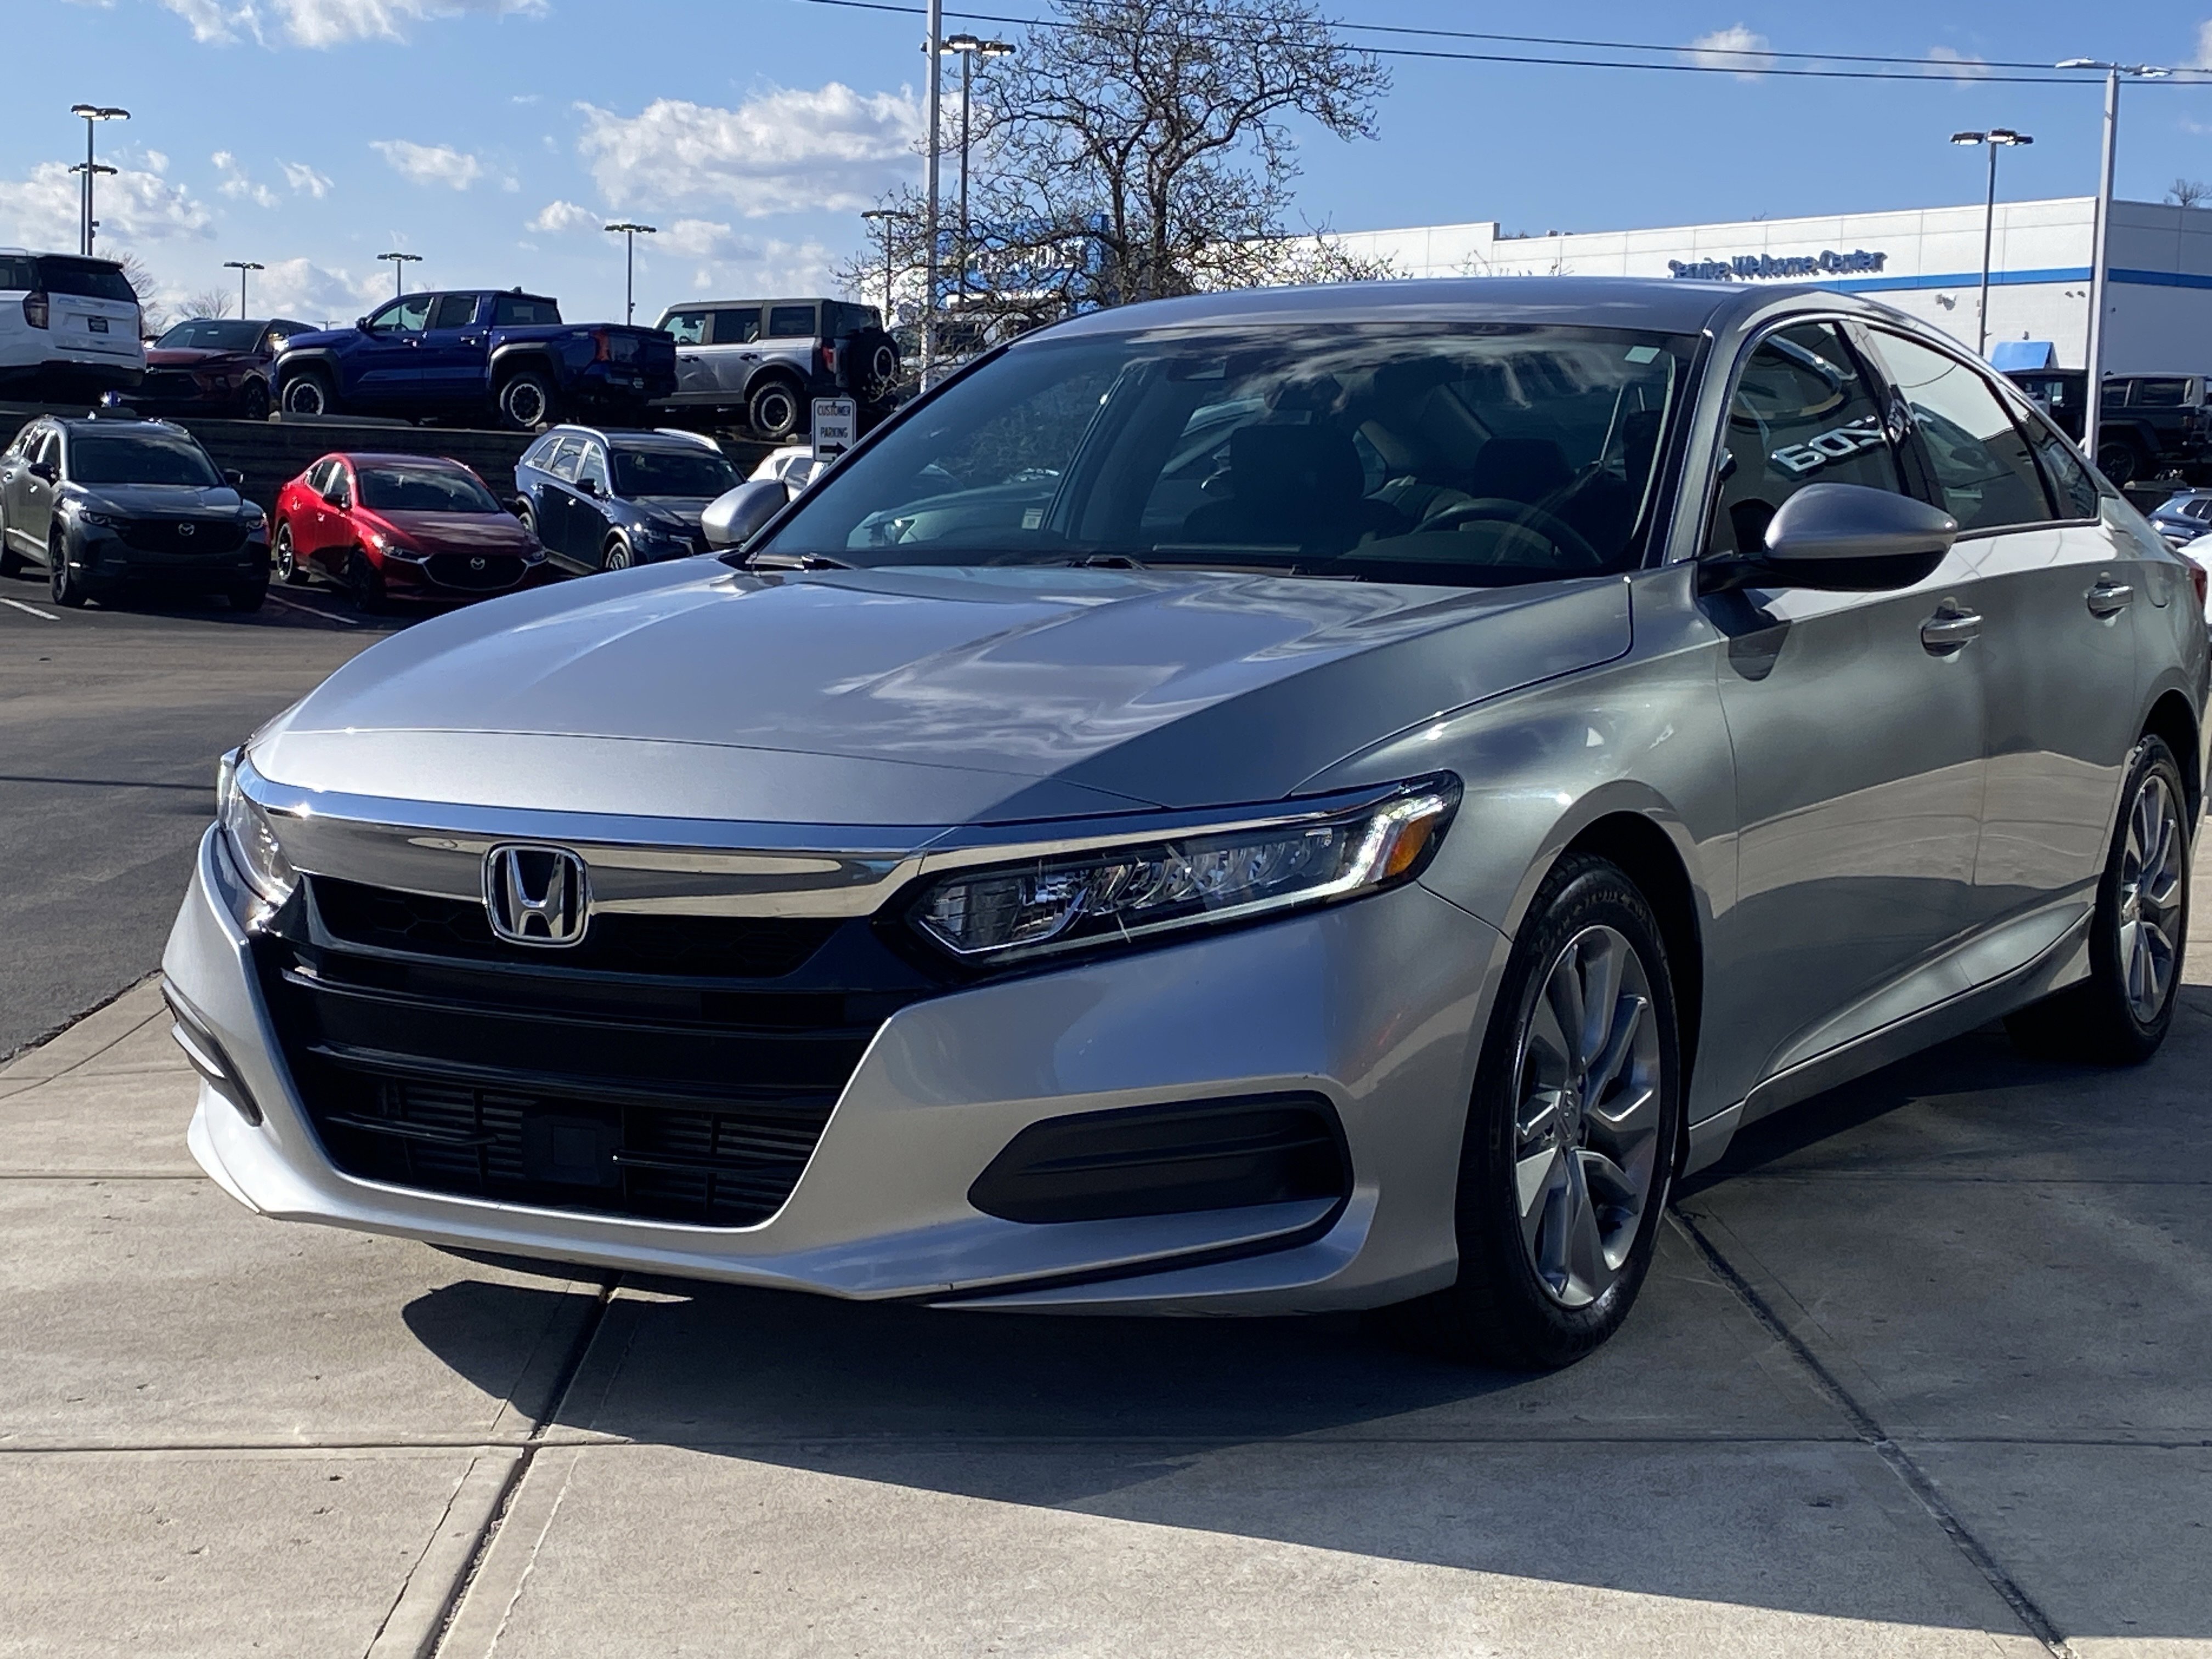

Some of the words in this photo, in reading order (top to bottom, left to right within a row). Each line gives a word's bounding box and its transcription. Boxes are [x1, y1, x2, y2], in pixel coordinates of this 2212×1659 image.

[1820, 249, 1888, 274] Center
[817, 406, 850, 416] CUSTOMER
[820, 427, 848, 438] PARKING
